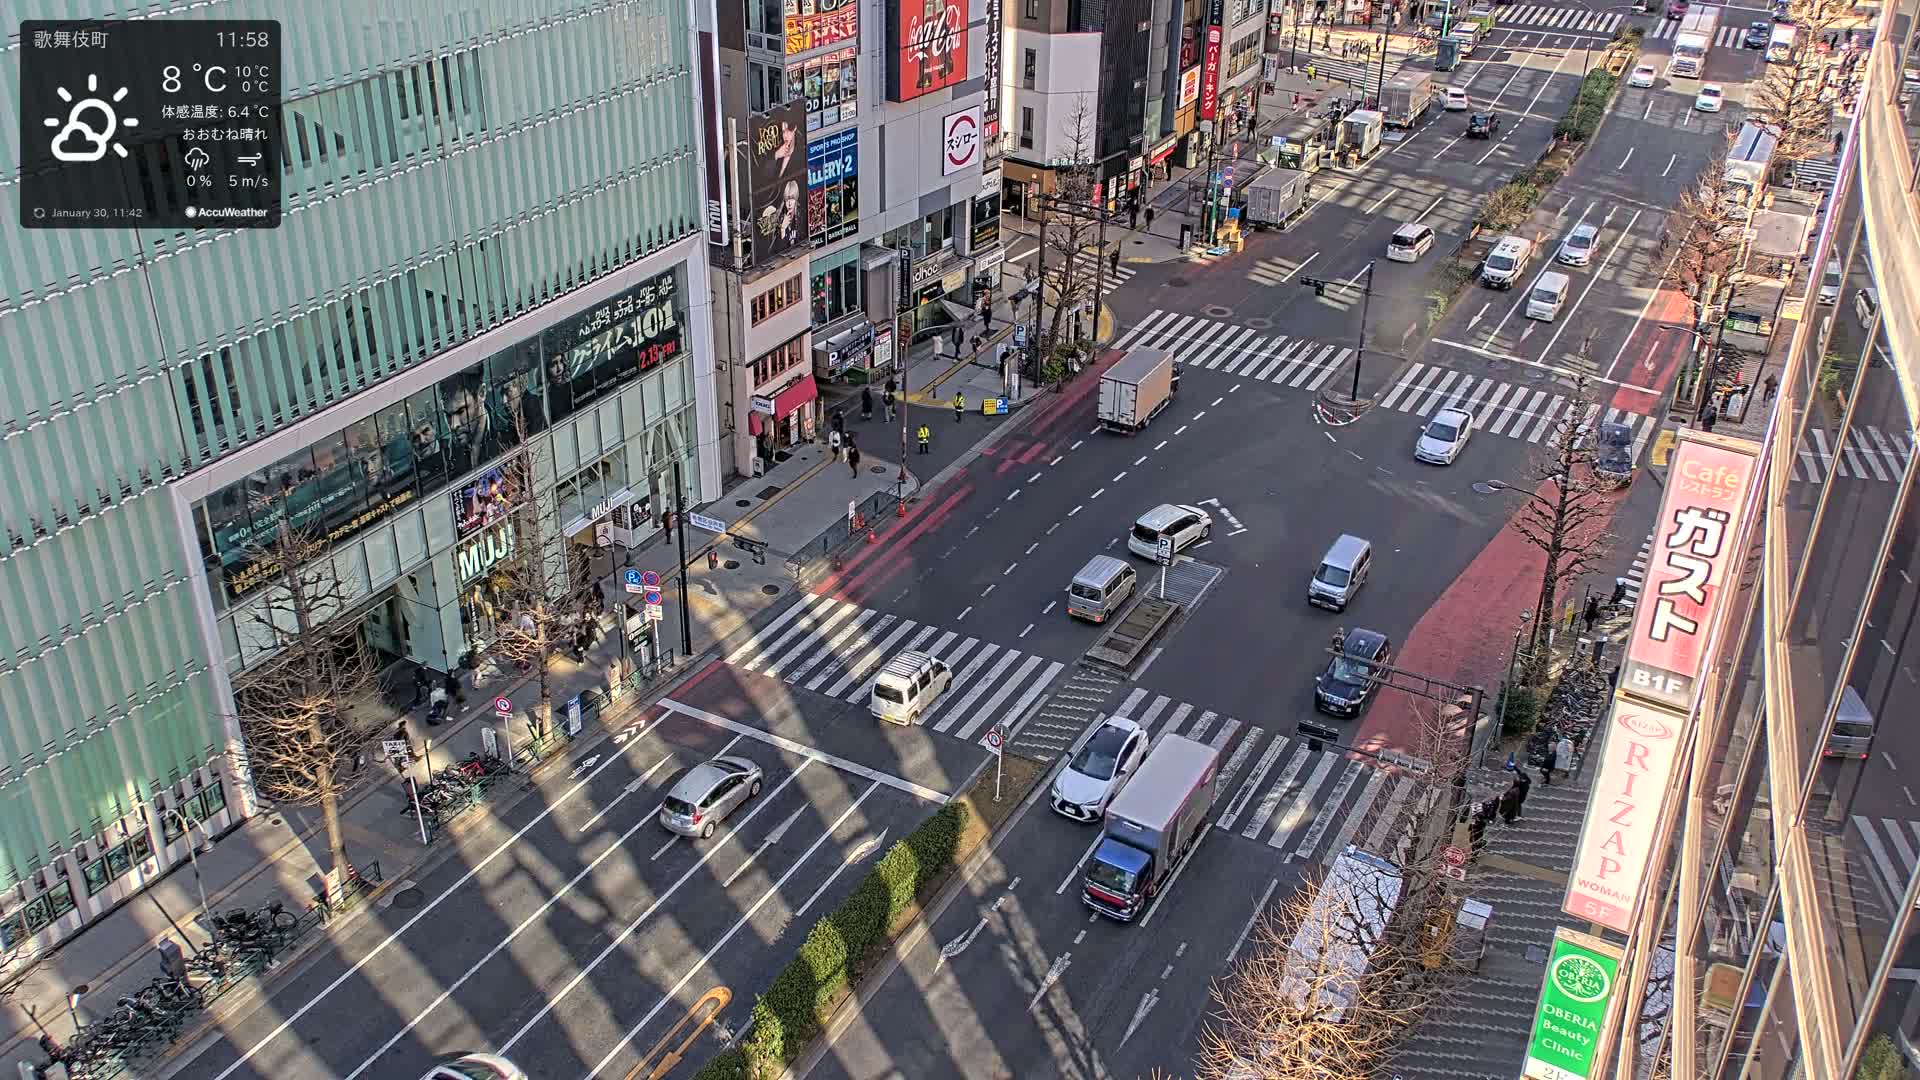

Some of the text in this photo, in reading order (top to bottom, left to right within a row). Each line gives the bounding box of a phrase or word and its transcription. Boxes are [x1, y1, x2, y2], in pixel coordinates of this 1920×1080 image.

[1205, 46, 1219, 110] バーガーキング
[823, 90, 851, 107] HALL
[810, 133, 855, 153] SPORTS PRO SHOP
[946, 132, 977, 152] スシロー
[709, 199, 721, 232] MUJI
[1017, 326, 1024, 334] P
[640, 340, 676, 369] 2.13 FRI
[828, 352, 837, 367] P
[996, 399, 1003, 408] P
[1682, 459, 1738, 488] Café
[1679, 480, 1735, 500] レストラン
[592, 496, 613, 520] MUJI
[458, 523, 514, 581] MUJI
[1160, 539, 1168, 549] P
[1649, 505, 1730, 642] ガスト
[1632, 669, 1682, 694] B1F
[1597, 741, 1649, 880] RIZAP
[1578, 879, 1630, 902] WOMAN
[1584, 900, 1610, 919] 5F
[1559, 969, 1600, 989] OBERIA
[1543, 1004, 1597, 1031] OBERIA
[1543, 1019, 1590, 1046] Beauty
[1542, 1038, 1584, 1060] Clinic
